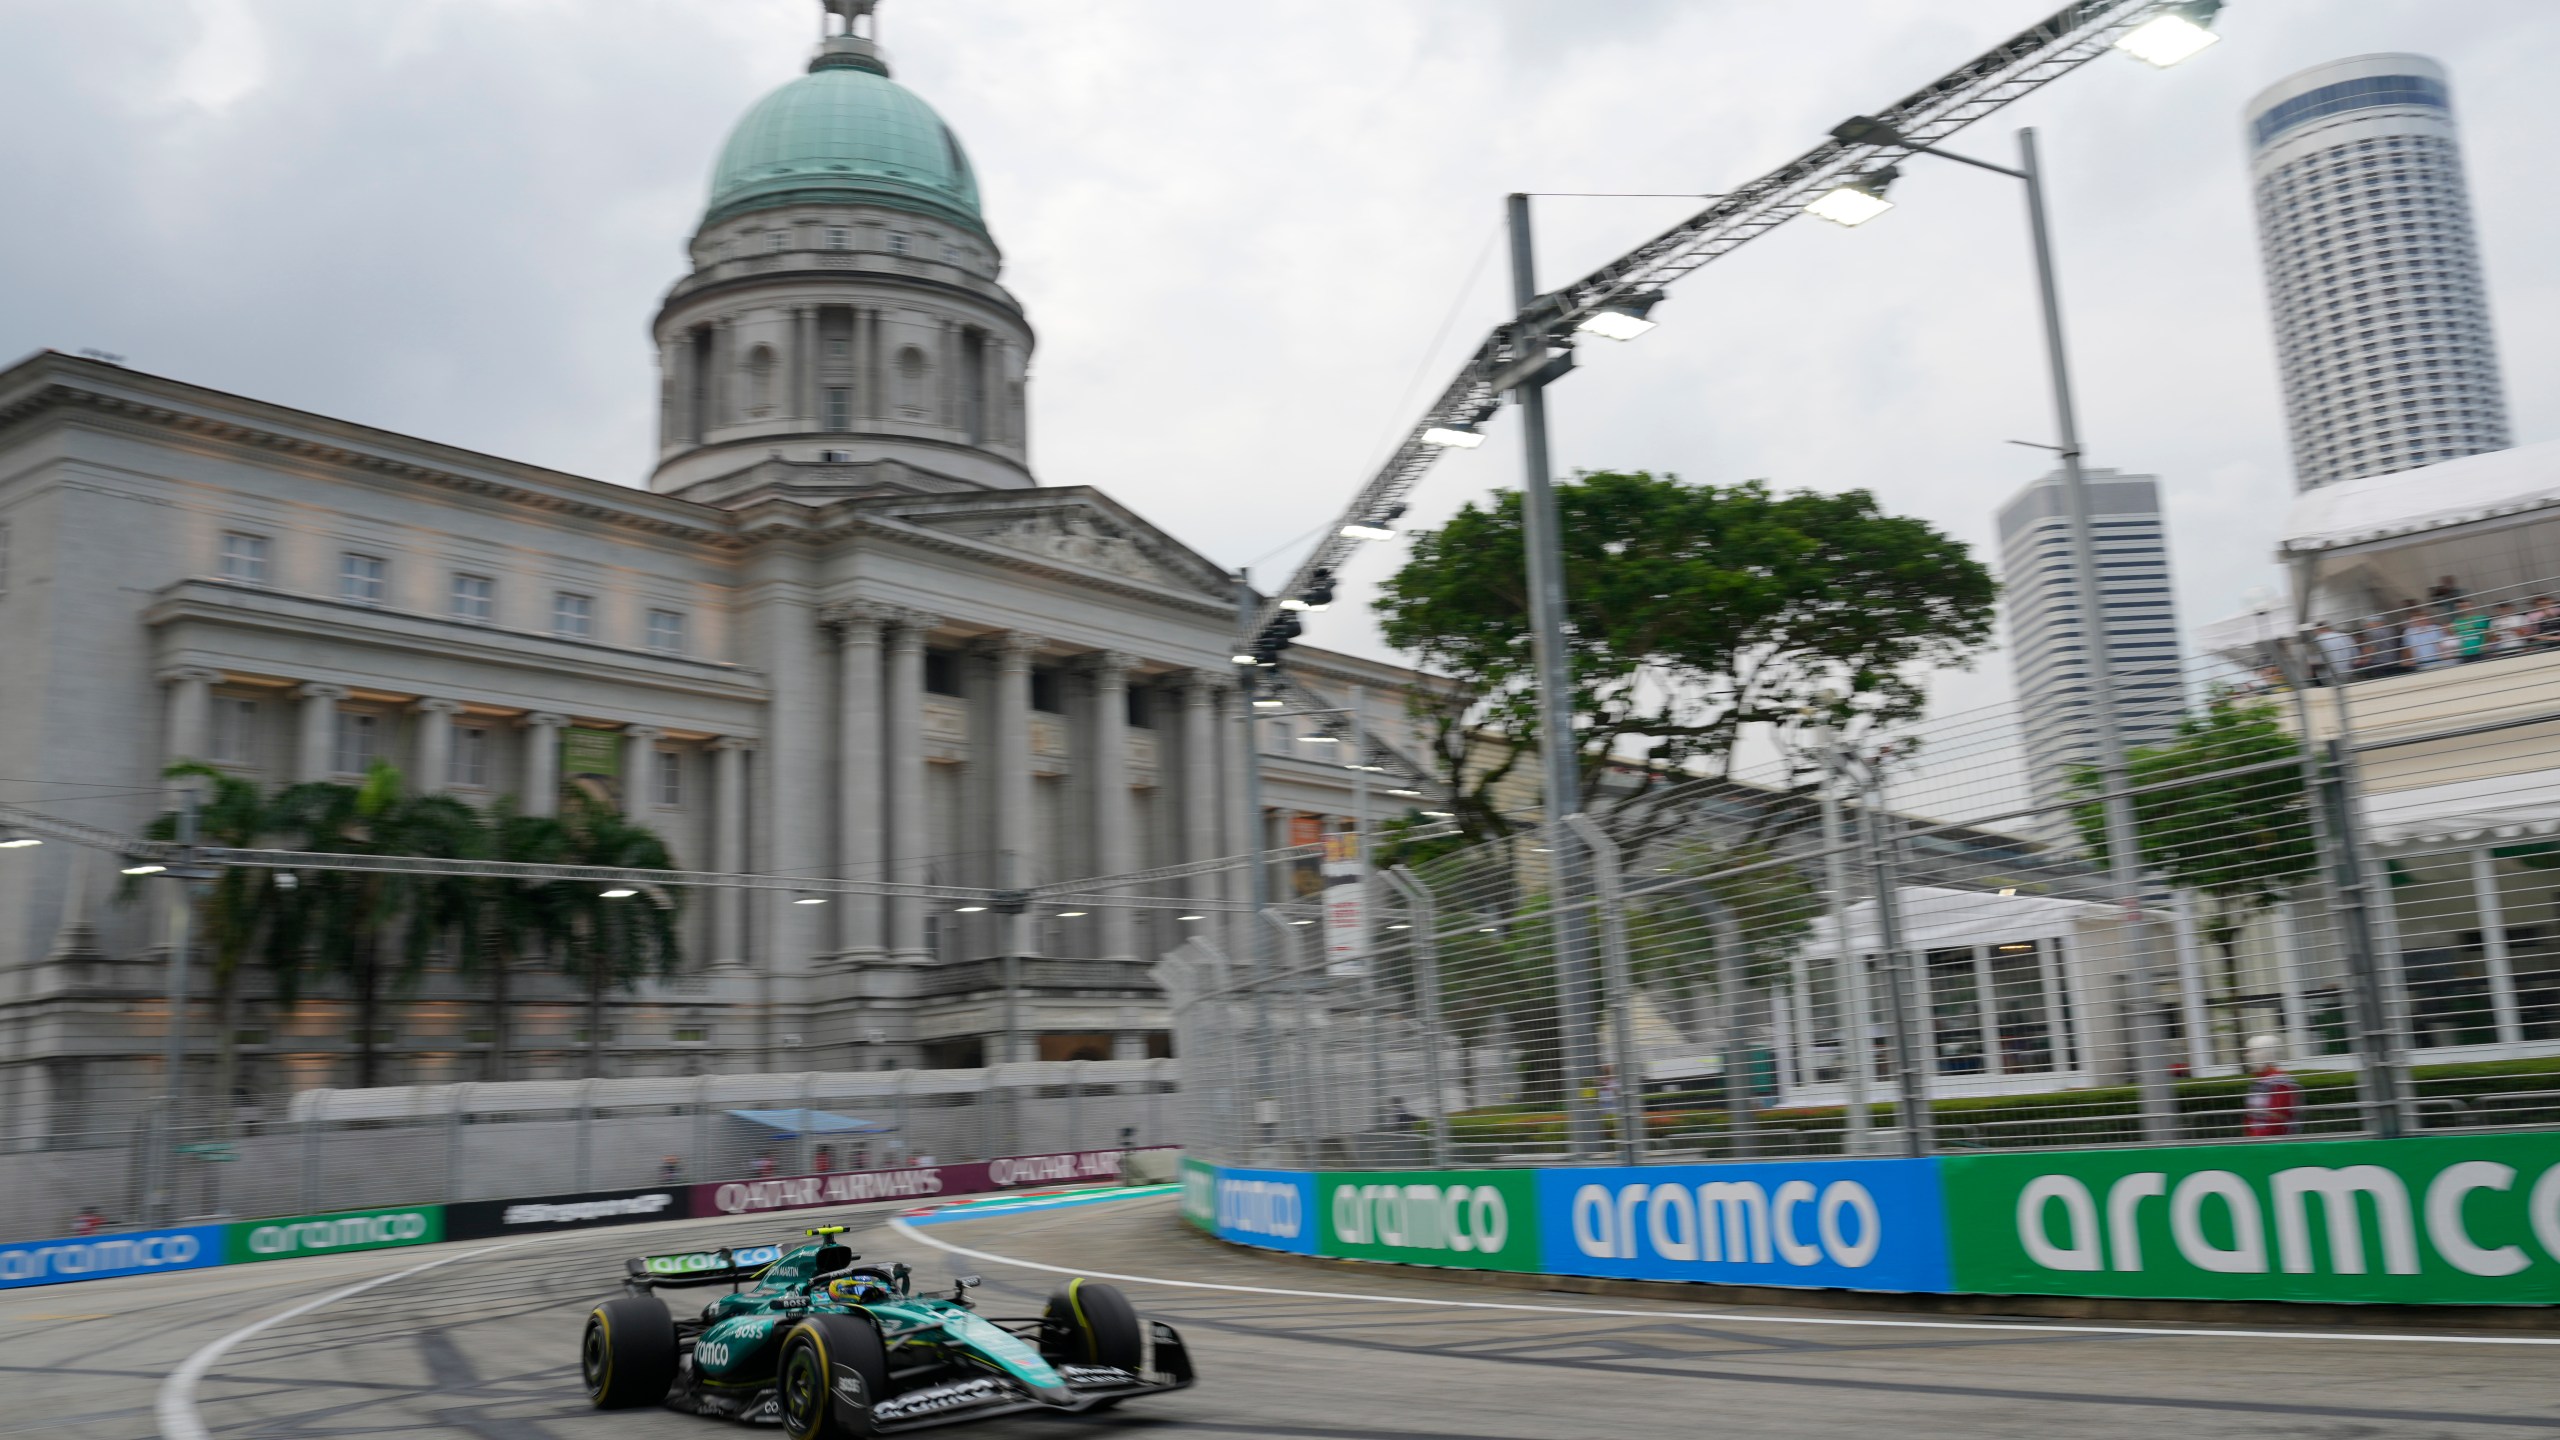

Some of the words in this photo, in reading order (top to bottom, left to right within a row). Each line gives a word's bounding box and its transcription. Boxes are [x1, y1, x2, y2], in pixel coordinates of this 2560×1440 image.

[715, 1178, 822, 1213] QATAR
[824, 1169, 942, 1200] AIRWAYS
[248, 1213, 428, 1253] aramco
[1332, 1184, 1508, 1254] aramco
[1571, 1180, 1882, 1268] aramco
[2016, 1160, 2560, 1277] aramc
[0, 1234, 199, 1280] aramco
[783, 1299, 807, 1308] BOSS
[735, 1325, 764, 1339] BOSS
[873, 1379, 994, 1420] aramco
